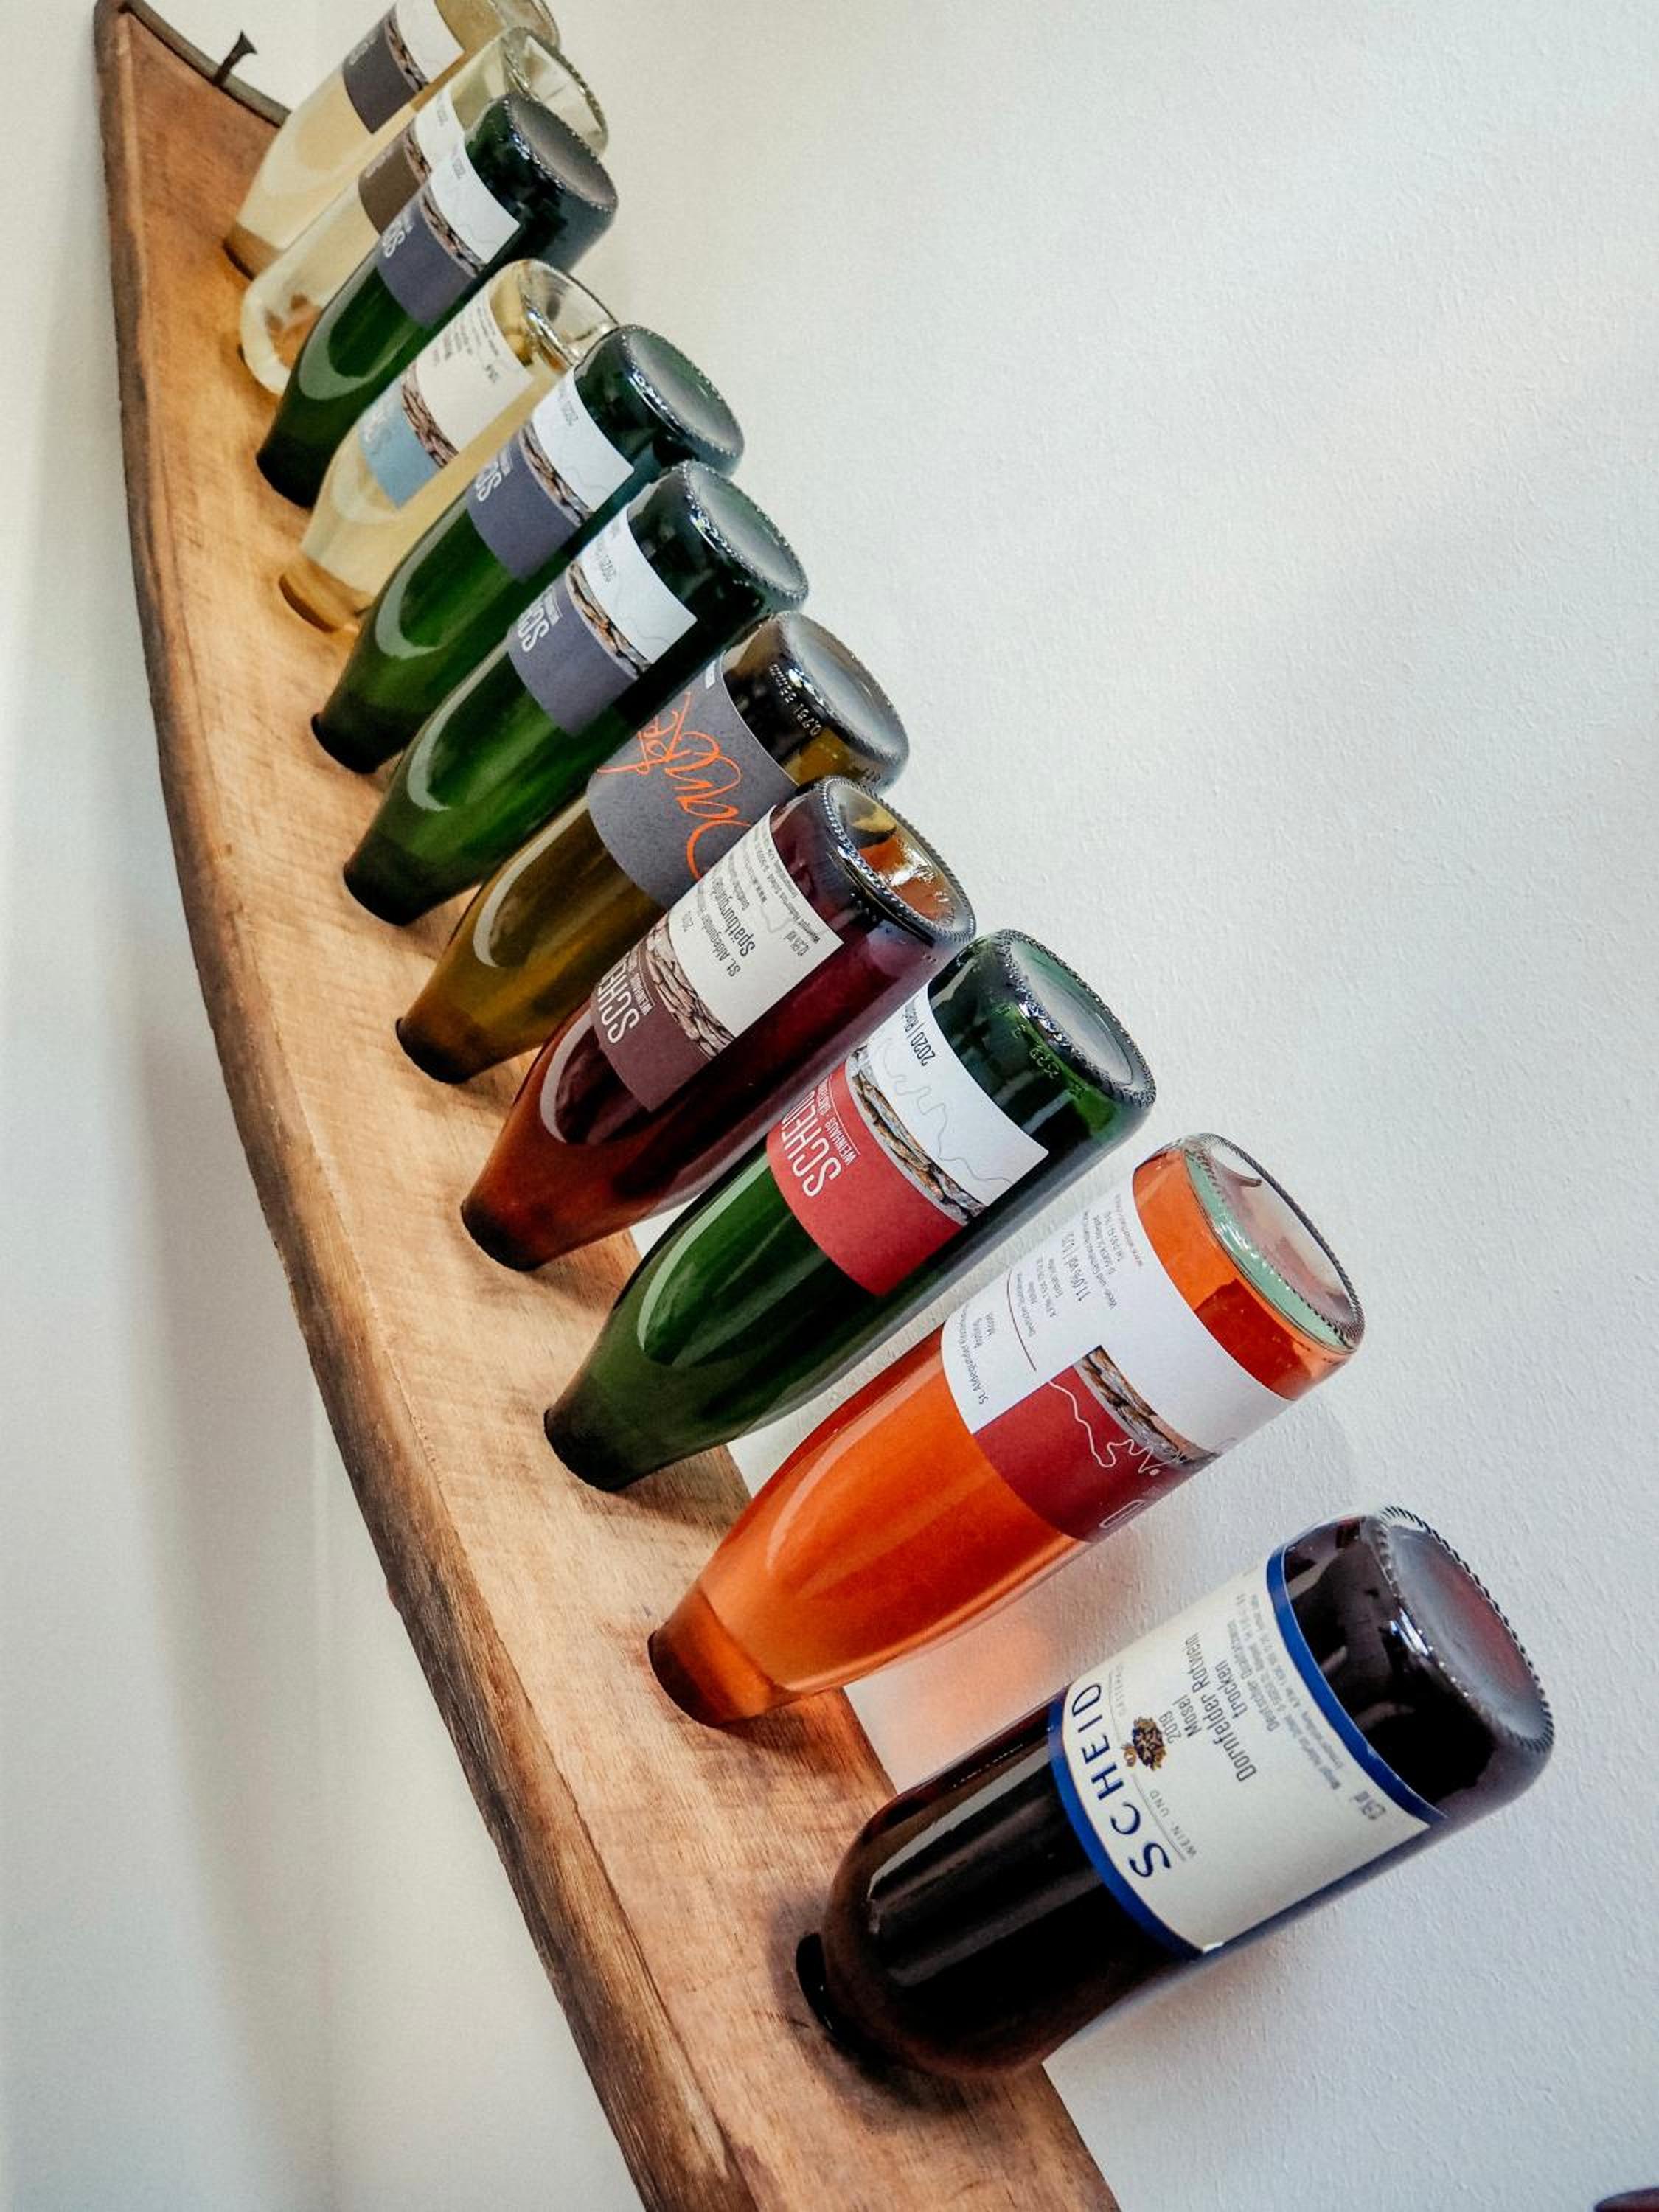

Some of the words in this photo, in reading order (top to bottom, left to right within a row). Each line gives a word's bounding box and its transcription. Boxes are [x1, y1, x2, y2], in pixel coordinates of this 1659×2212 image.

[909, 1031, 936, 1066] 2020
[824, 1116, 856, 1165] WEINHAUS
[1183, 1632, 1208, 1693] Rotwein
[1212, 1659, 1248, 1719] trocken
[1244, 1677, 1281, 1732] Deutscher
[1157, 1709, 1182, 1744] 2019
[1172, 1694, 1203, 1737] Mosel
[1199, 1690, 1256, 1781] Dornfelder
[1070, 1686, 1171, 1877] SCHEID
[1149, 1788, 1169, 1816] UND
